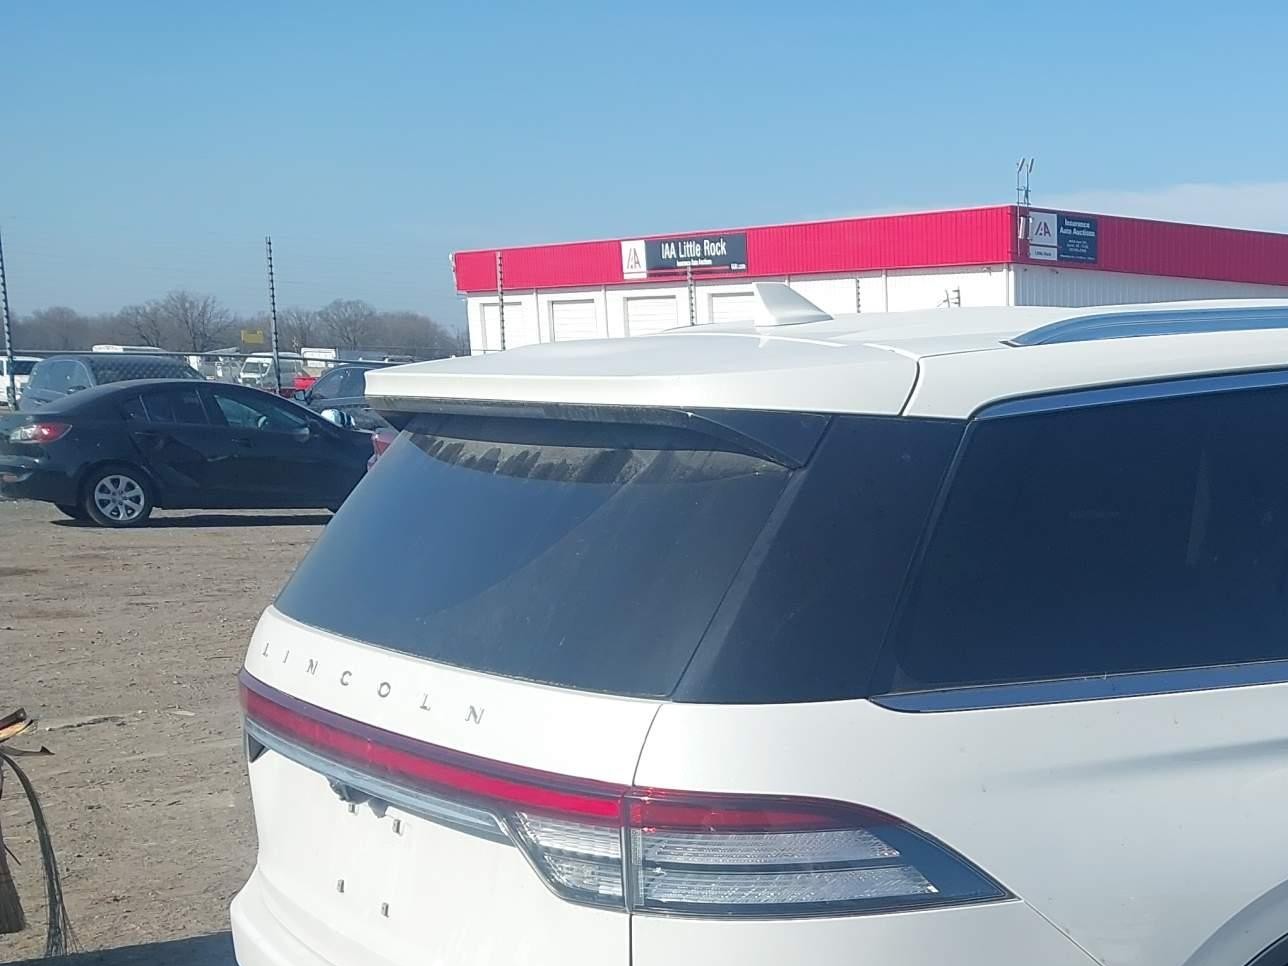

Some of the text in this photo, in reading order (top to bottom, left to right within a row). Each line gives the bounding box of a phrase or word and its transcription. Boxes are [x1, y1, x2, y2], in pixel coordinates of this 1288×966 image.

[1060, 226, 1095, 237] Auto Auctions
[661, 238, 727, 259] IAA Little Rock
[262, 642, 485, 724] LINCOLN
